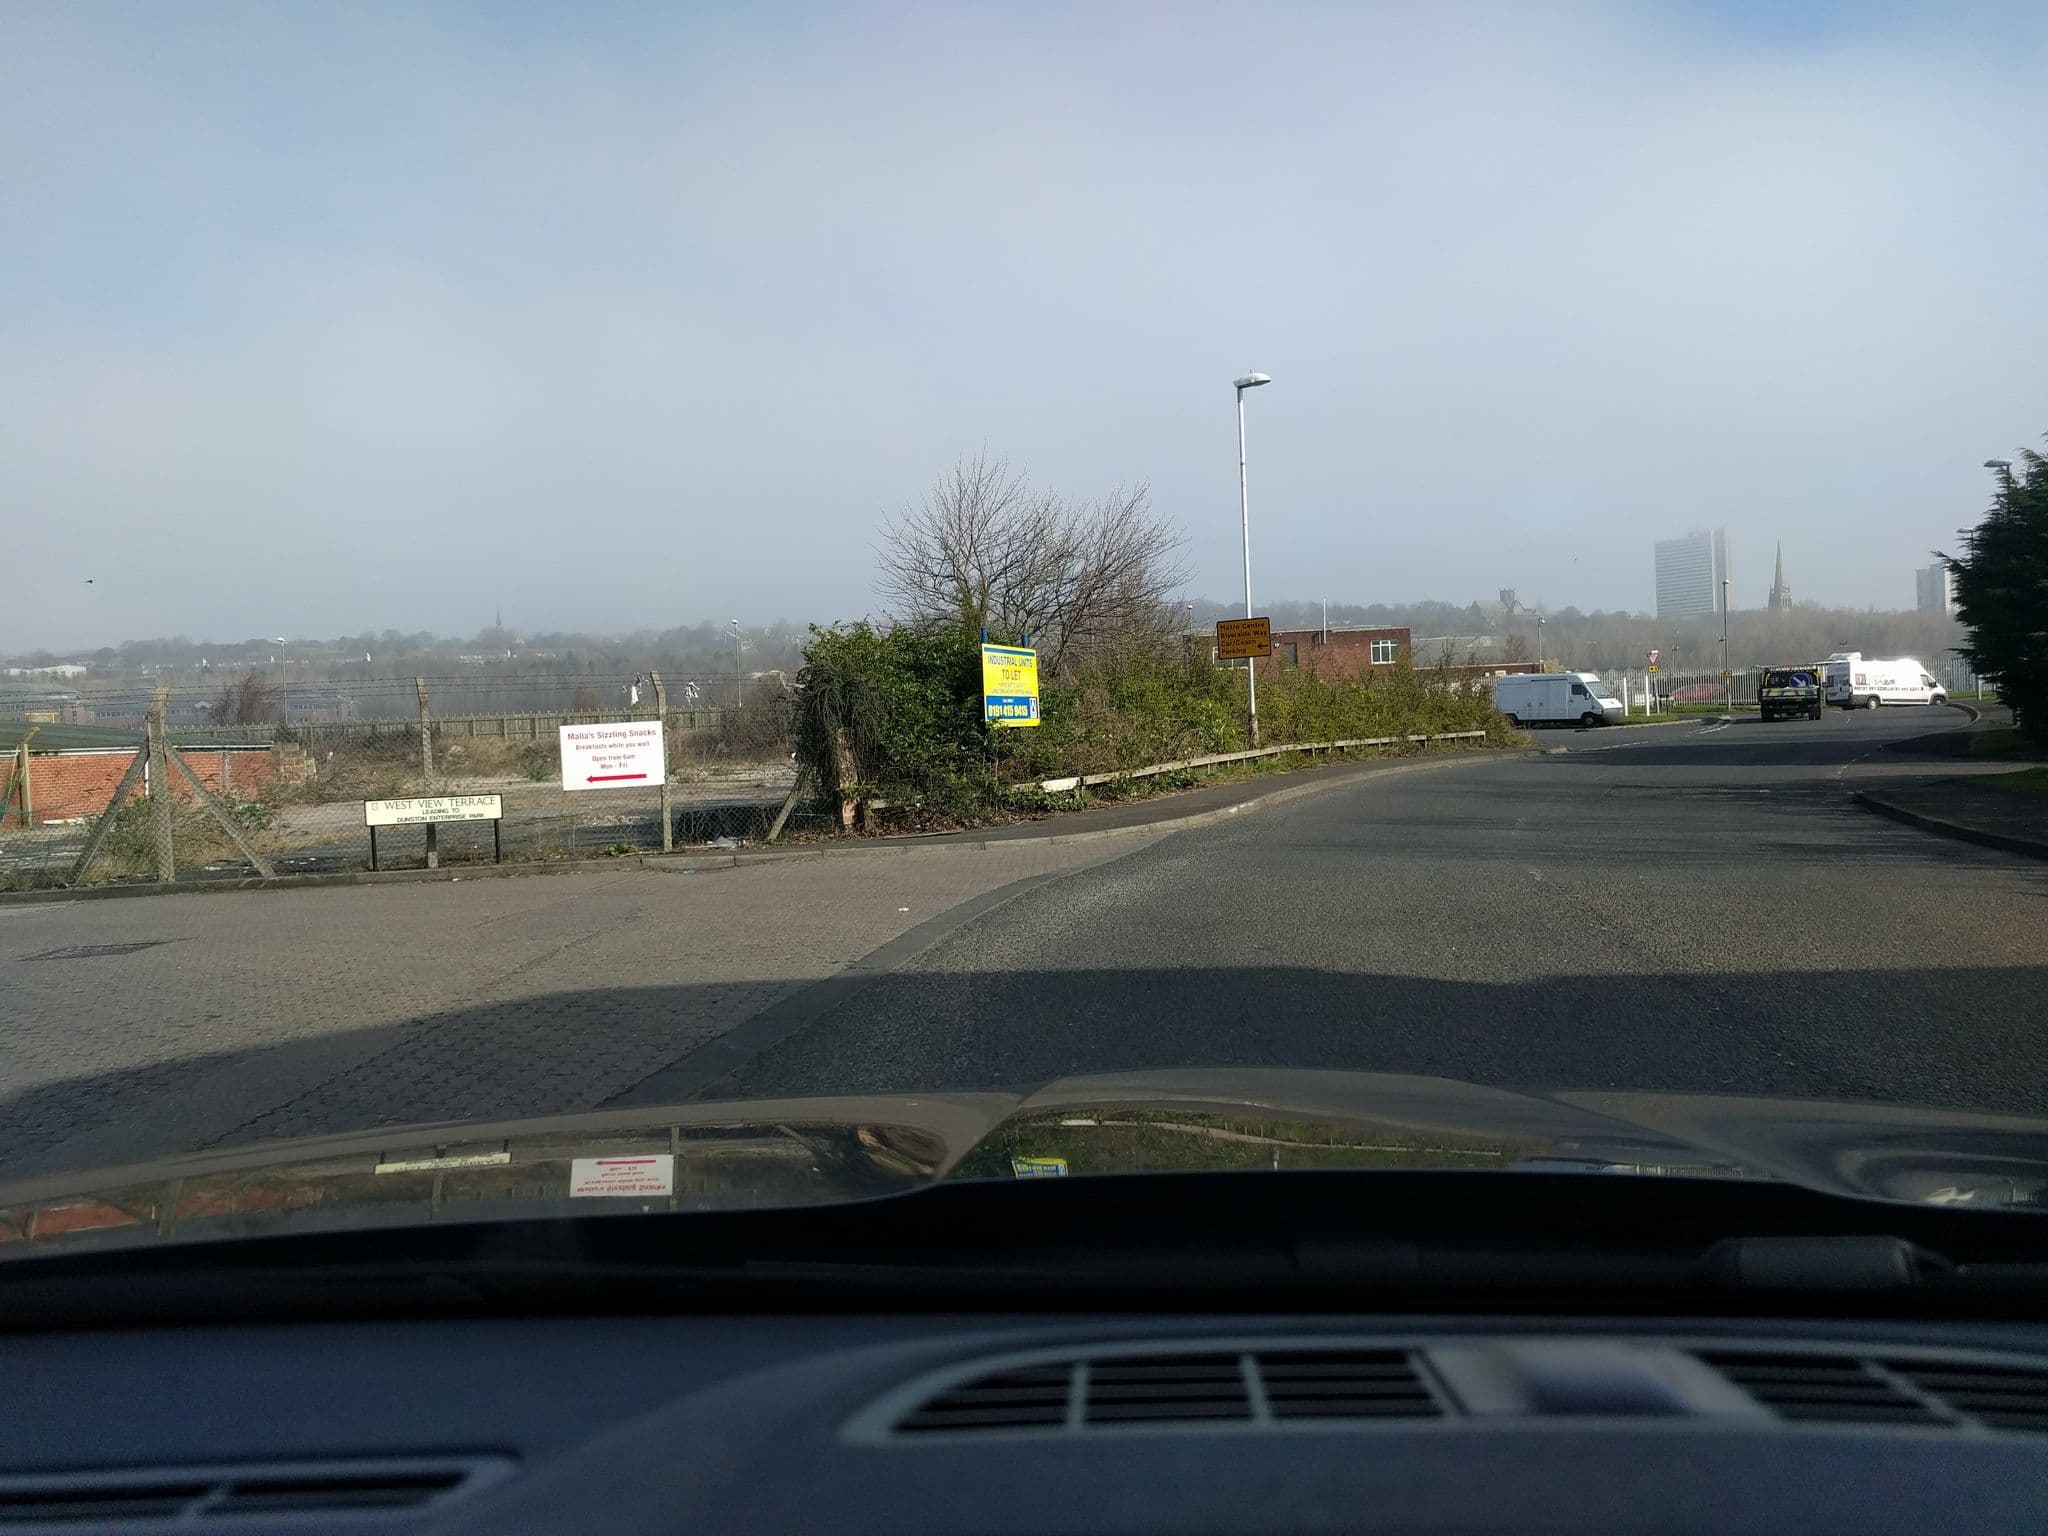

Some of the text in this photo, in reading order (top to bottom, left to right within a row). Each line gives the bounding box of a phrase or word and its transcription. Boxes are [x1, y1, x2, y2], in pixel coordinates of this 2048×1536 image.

[1220, 639, 1257, 647] Car/Coach
[1221, 648, 1247, 656] Parking
[988, 655, 1033, 668] INDUSTRIAL UNITS
[1001, 668, 1021, 680] TO LET
[988, 705, 1003, 716] 0191
[597, 730, 627, 739] Sizzling
[629, 729, 656, 737] Snacks
[384, 796, 497, 810] WEST VIEW TERRACE
[396, 815, 428, 823] DUNSTON
[429, 813, 466, 821] ENTERPRISE
